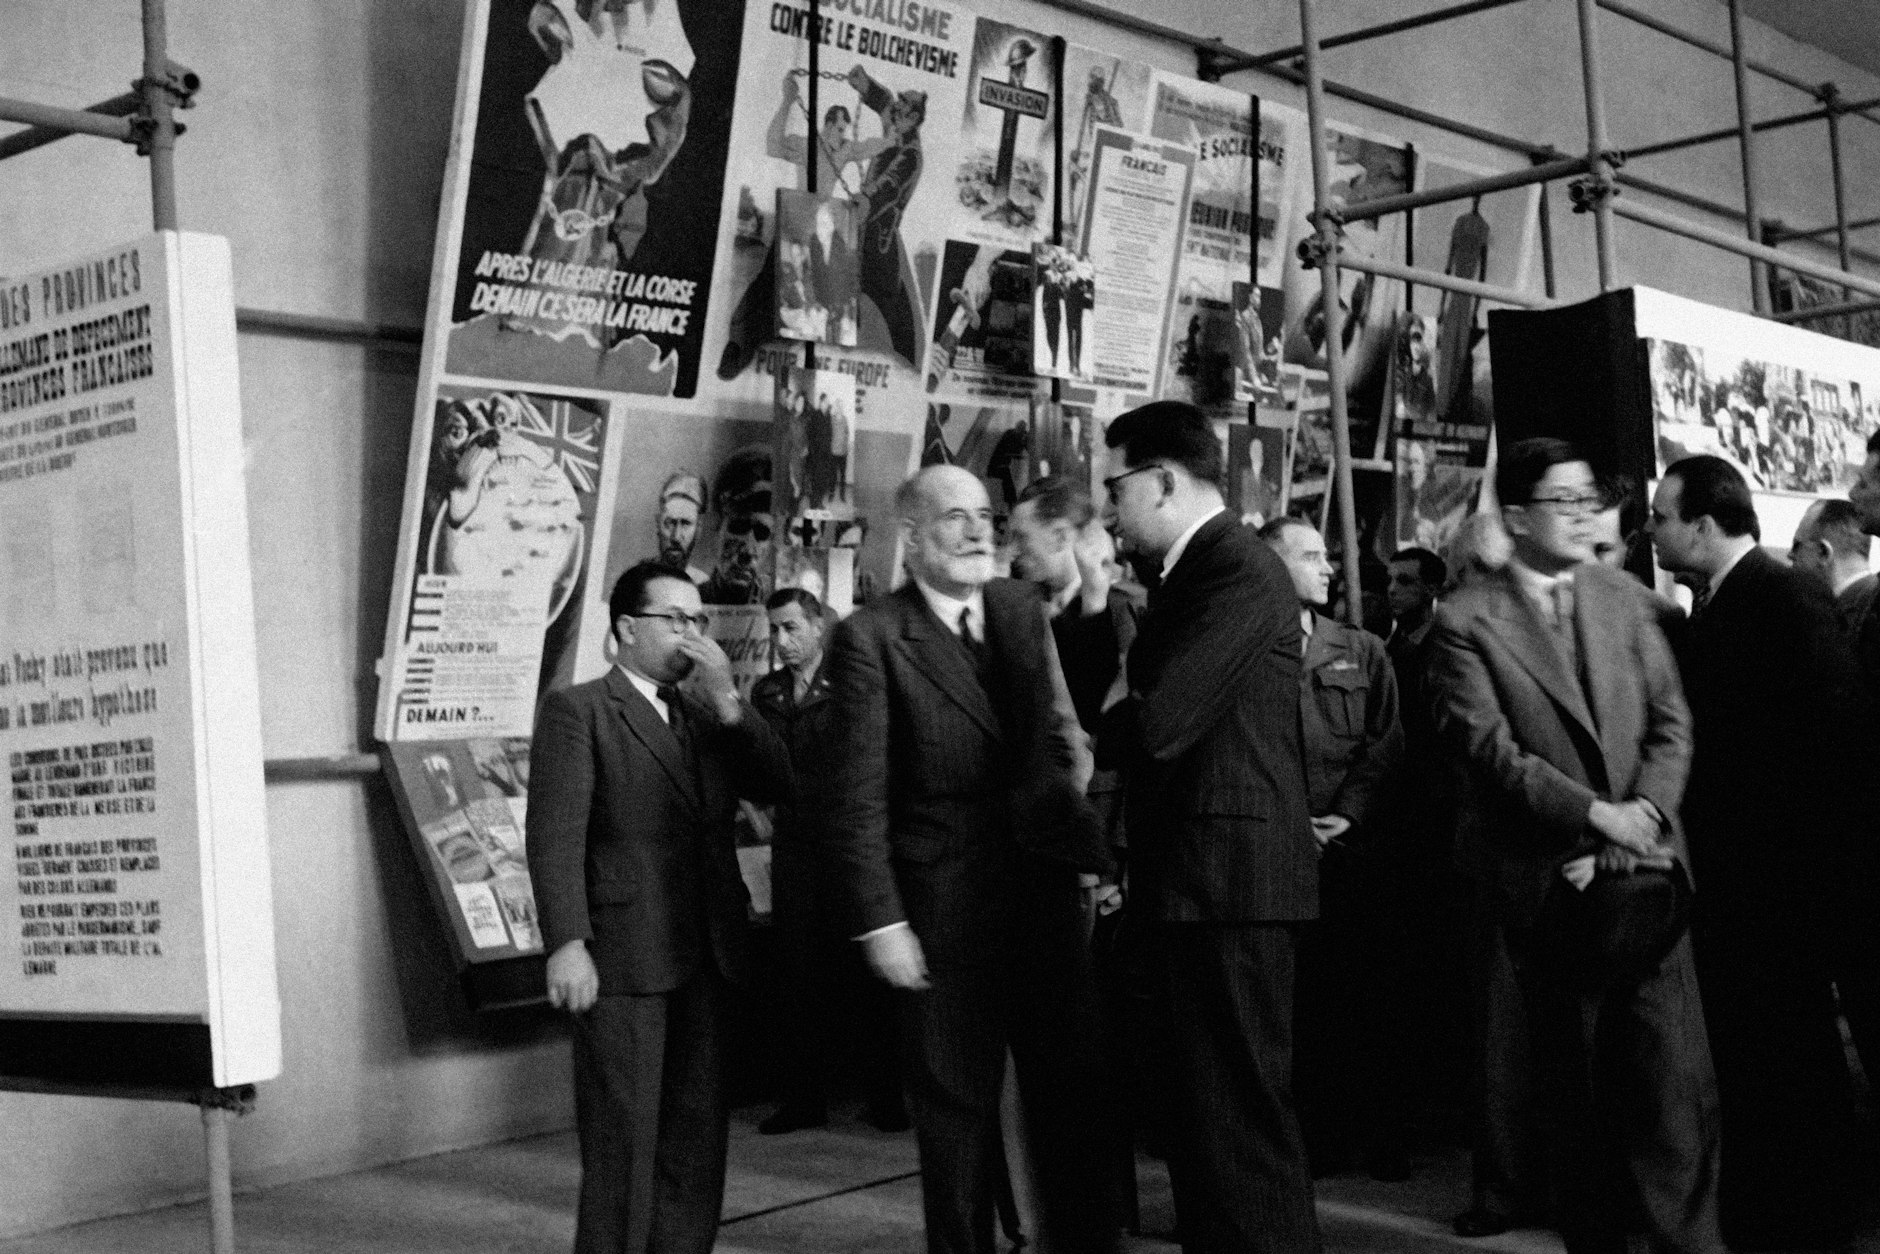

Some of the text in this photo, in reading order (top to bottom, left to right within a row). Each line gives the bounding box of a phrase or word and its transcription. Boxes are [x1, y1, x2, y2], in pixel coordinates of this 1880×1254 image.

[819, 0, 952, 40] CIALISME
[836, 20, 855, 50] LE
[858, 27, 959, 78] BOLCHEVISME
[984, 85, 1044, 111] INVASION
[1, 249, 141, 329] DES PROVINCES
[474, 250, 532, 282] APRES
[605, 269, 629, 295] ET
[624, 273, 646, 299] LA
[645, 275, 697, 305] CORSE
[469, 282, 542, 317] DEMAIN
[605, 299, 628, 328] LA
[626, 303, 691, 336] FRANCE
[54, 328, 69, 361] DE
[143, 641, 168, 676] que
[406, 707, 467, 723] DEMAIN
